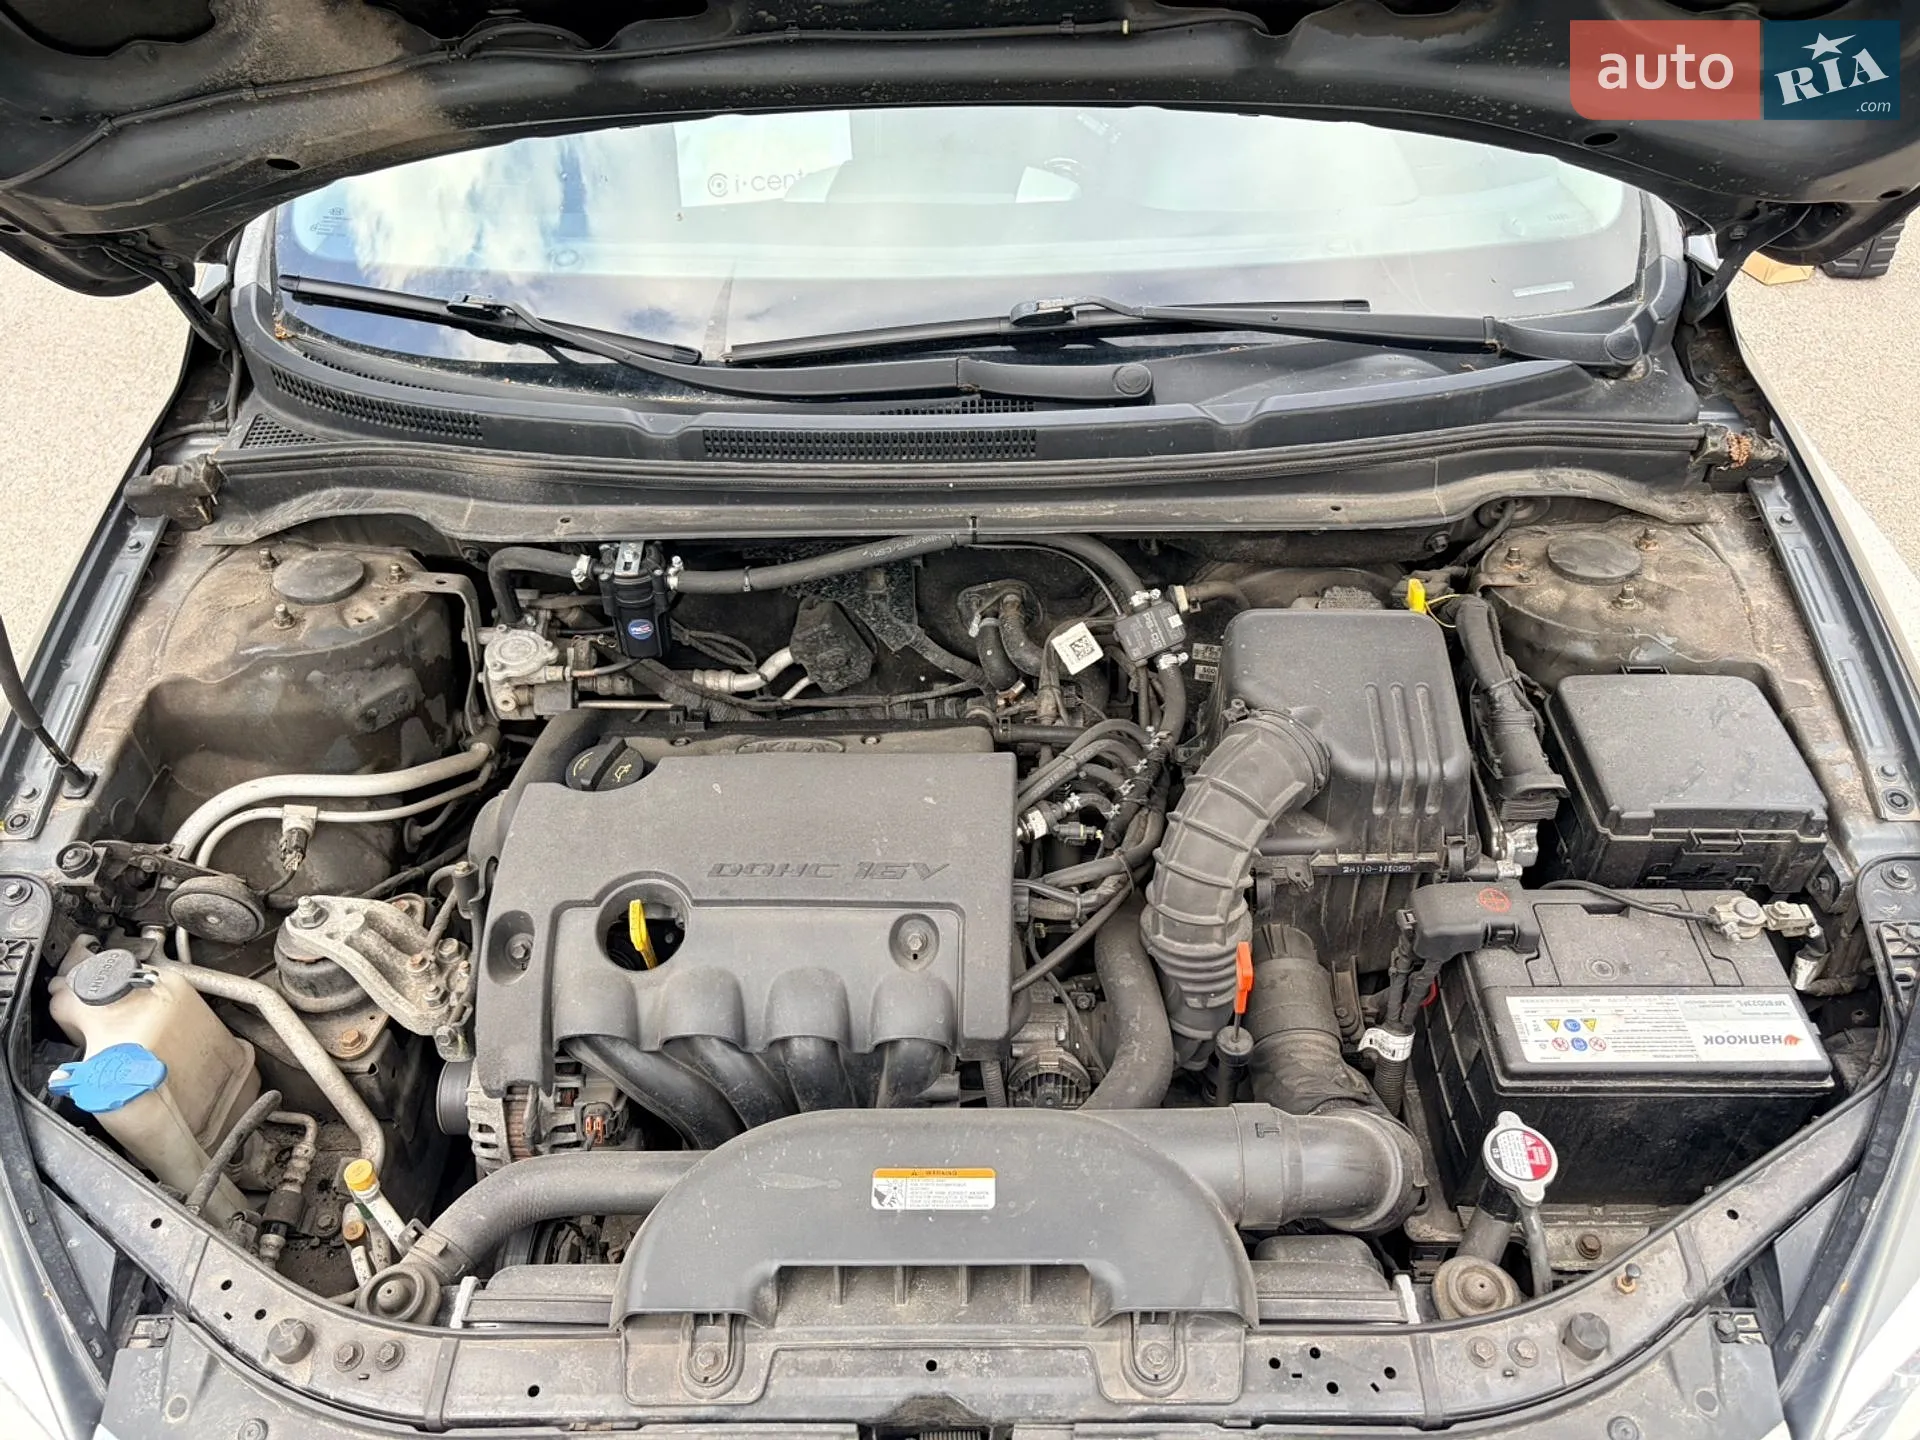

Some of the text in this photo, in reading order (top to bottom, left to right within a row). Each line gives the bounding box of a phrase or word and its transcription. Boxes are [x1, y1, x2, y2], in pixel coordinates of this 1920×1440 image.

[707, 861, 950, 881] DOHC 16V
[88, 952, 121, 994] COOLANT
